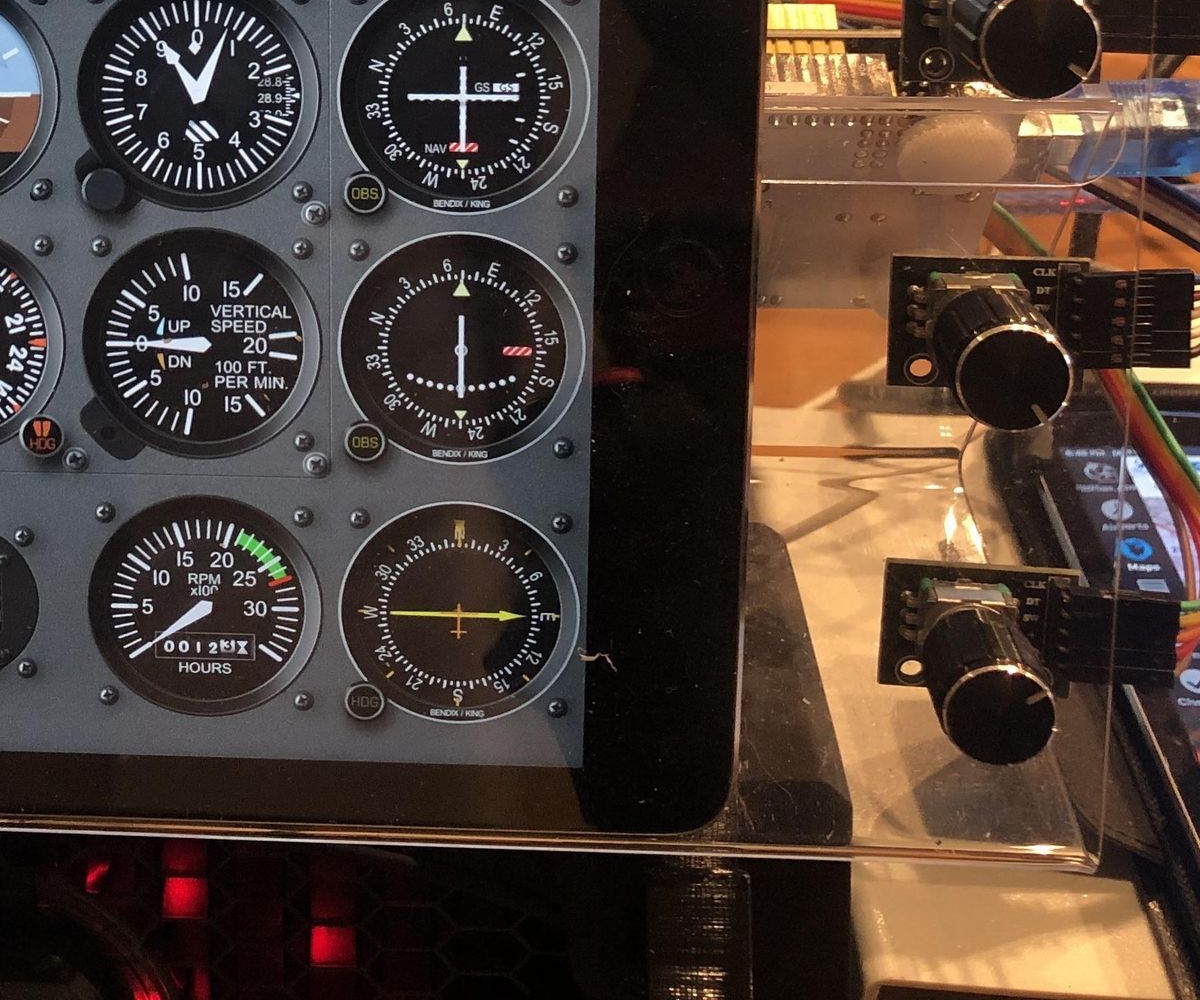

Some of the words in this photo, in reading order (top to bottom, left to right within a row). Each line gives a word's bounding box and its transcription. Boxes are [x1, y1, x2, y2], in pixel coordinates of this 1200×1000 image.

[474, 82, 490, 92] GS
[257, 93, 283, 104] 28.9
[424, 143, 447, 154] NAV
[351, 187, 379, 199] OBS
[433, 199, 463, 208] BENDIX
[470, 200, 491, 208] KING
[1033, 267, 1057, 276] CLK
[183, 284, 200, 302] 10
[223, 280, 241, 298] 15
[210, 304, 292, 319] VERTICAL
[168, 320, 191, 333] UP
[210, 320, 267, 333] SPEED
[243, 337, 267, 354] 20
[168, 355, 192, 368] DN
[215, 361, 242, 374] 100
[248, 361, 272, 375] FT.
[214, 376, 249, 389] PER
[254, 376, 289, 390] MIN.
[184, 389, 202, 406] 10
[224, 396, 242, 413] 15
[351, 436, 379, 448] OBS
[432, 449, 462, 458] BENDIX
[468, 450, 488, 459] KING
[176, 550, 194, 567] 15
[210, 551, 234, 569] 20
[153, 569, 171, 586] 10
[188, 573, 221, 585] RPM
[232, 570, 257, 587] 25
[243, 600, 267, 617] 30
[178, 661, 232, 674] HOURS
[430, 709, 459, 717] BENDIX
[465, 709, 485, 718] KING
